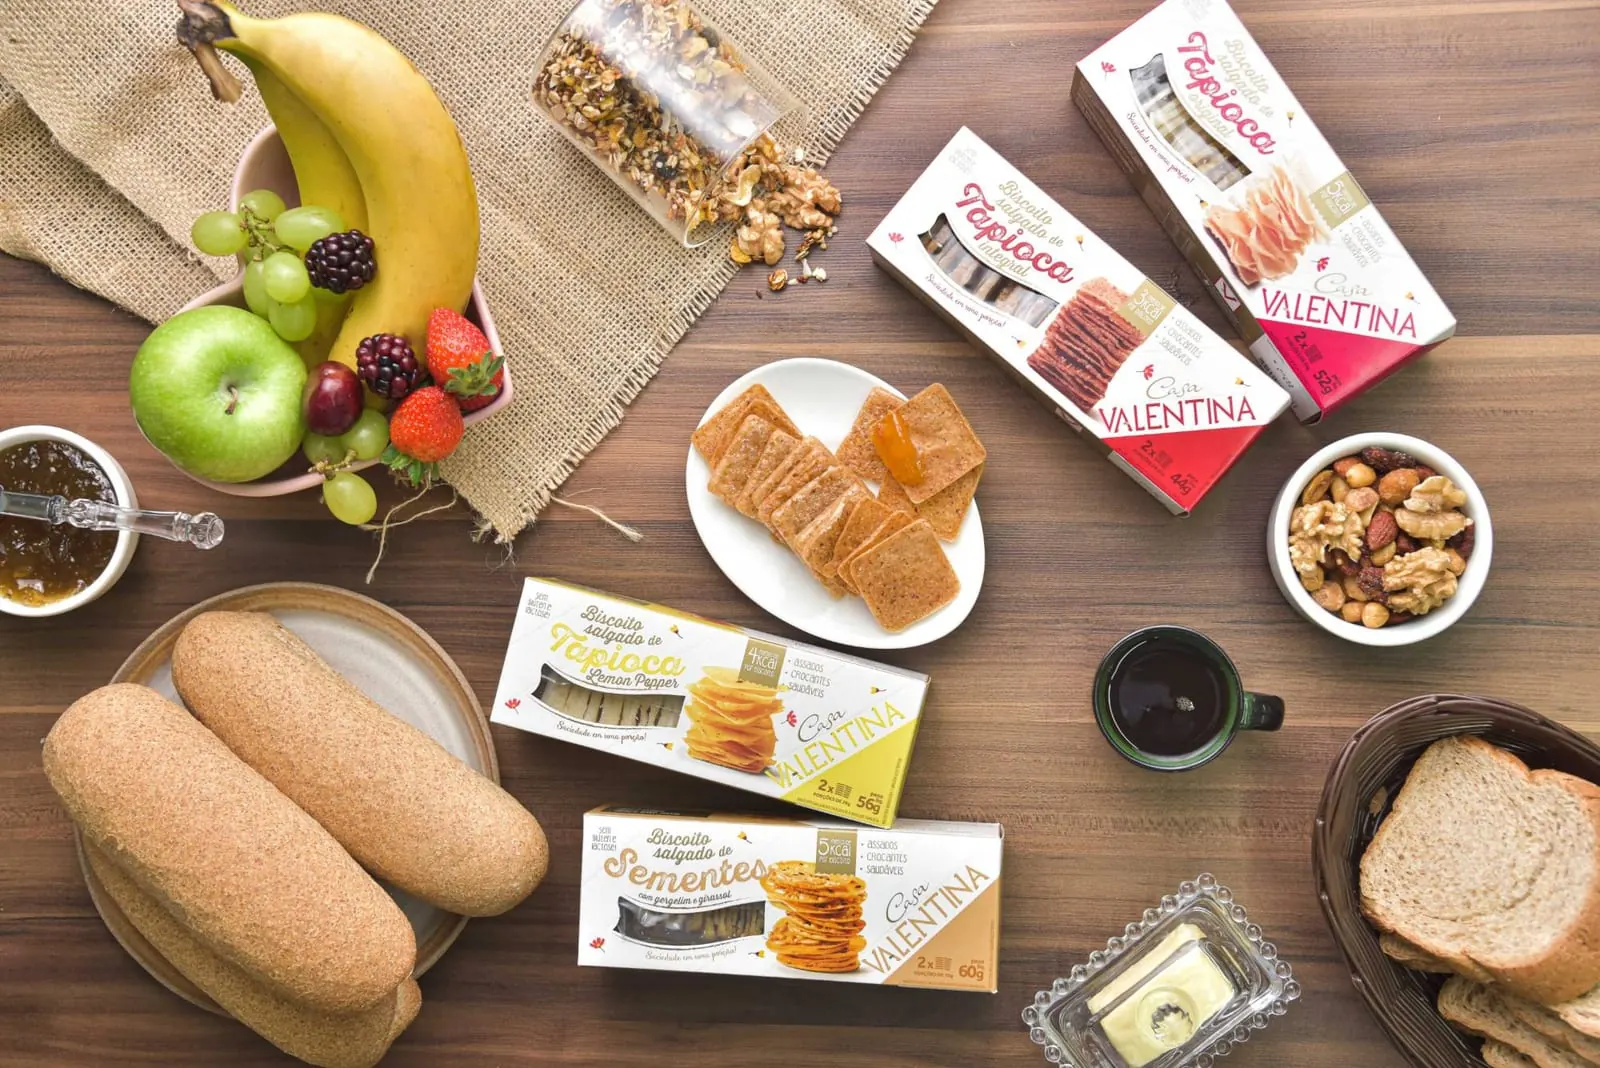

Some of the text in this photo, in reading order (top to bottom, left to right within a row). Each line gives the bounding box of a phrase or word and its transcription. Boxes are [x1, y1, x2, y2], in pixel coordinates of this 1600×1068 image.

[1224, 39, 1269, 94] Biscoito
[1177, 31, 1276, 155] Tapioca
[1217, 55, 1274, 118] salgado de
[1188, 94, 1234, 138] original
[999, 180, 1053, 226] Biscoito
[956, 182, 1074, 284] Tapioca
[995, 198, 1065, 248] salgado de
[978, 239, 1034, 278] integral
[1314, 273, 1373, 297] Casa
[1262, 287, 1417, 339] VALENTINA
[1146, 376, 1203, 400] Casa
[1313, 369, 1333, 396] 52g
[1098, 396, 1256, 433] VALENTINA
[1170, 474, 1191, 495] 44g
[580, 605, 644, 631] Biscoito
[583, 623, 663, 646] salgado de
[550, 621, 686, 677] Tapioca
[585, 667, 680, 690] Lemon Pepper
[764, 701, 906, 789] VALENTINA
[797, 710, 847, 742] Casa
[856, 795, 881, 815] 56g
[646, 828, 712, 847] Biscoito
[652, 845, 733, 865] salgado de
[604, 848, 770, 893] Sementes
[638, 892, 653, 902] com
[699, 890, 733, 906] girassol
[885, 882, 930, 923] Casa
[862, 864, 990, 974] VALENTINA
[958, 964, 985, 982] 60g
